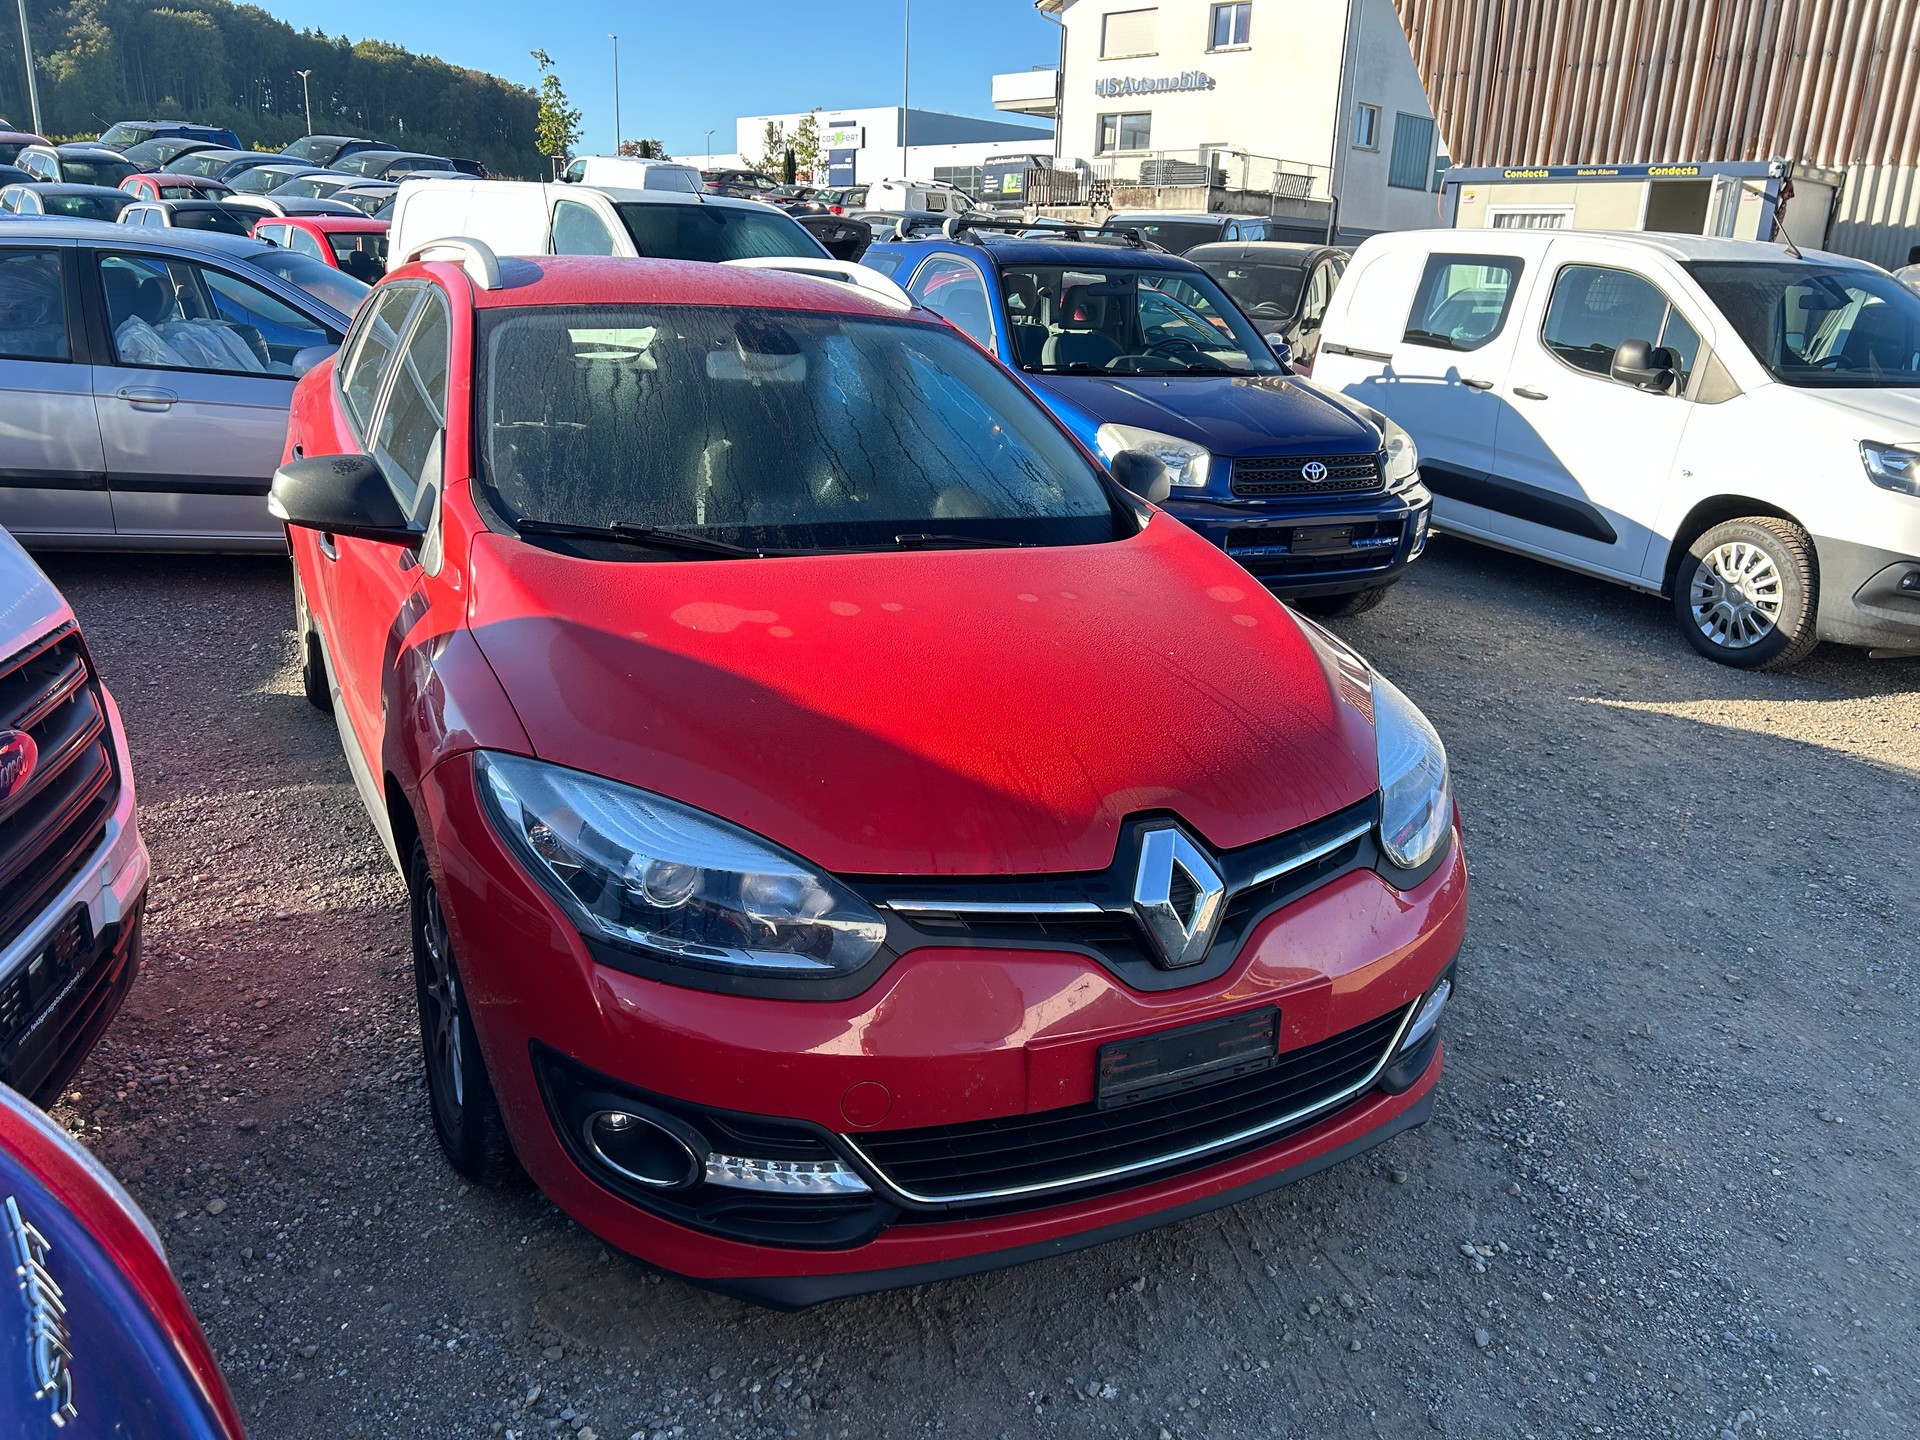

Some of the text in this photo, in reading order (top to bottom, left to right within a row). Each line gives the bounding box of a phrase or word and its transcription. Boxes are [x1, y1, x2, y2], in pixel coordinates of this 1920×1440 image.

[1094, 70, 1209, 96] HIS Automobile
[1504, 169, 1549, 178] Condecta
[1648, 166, 1698, 176] Condecta
[1733, 528, 1768, 542] SPORT
[0, 744, 29, 788] ord
